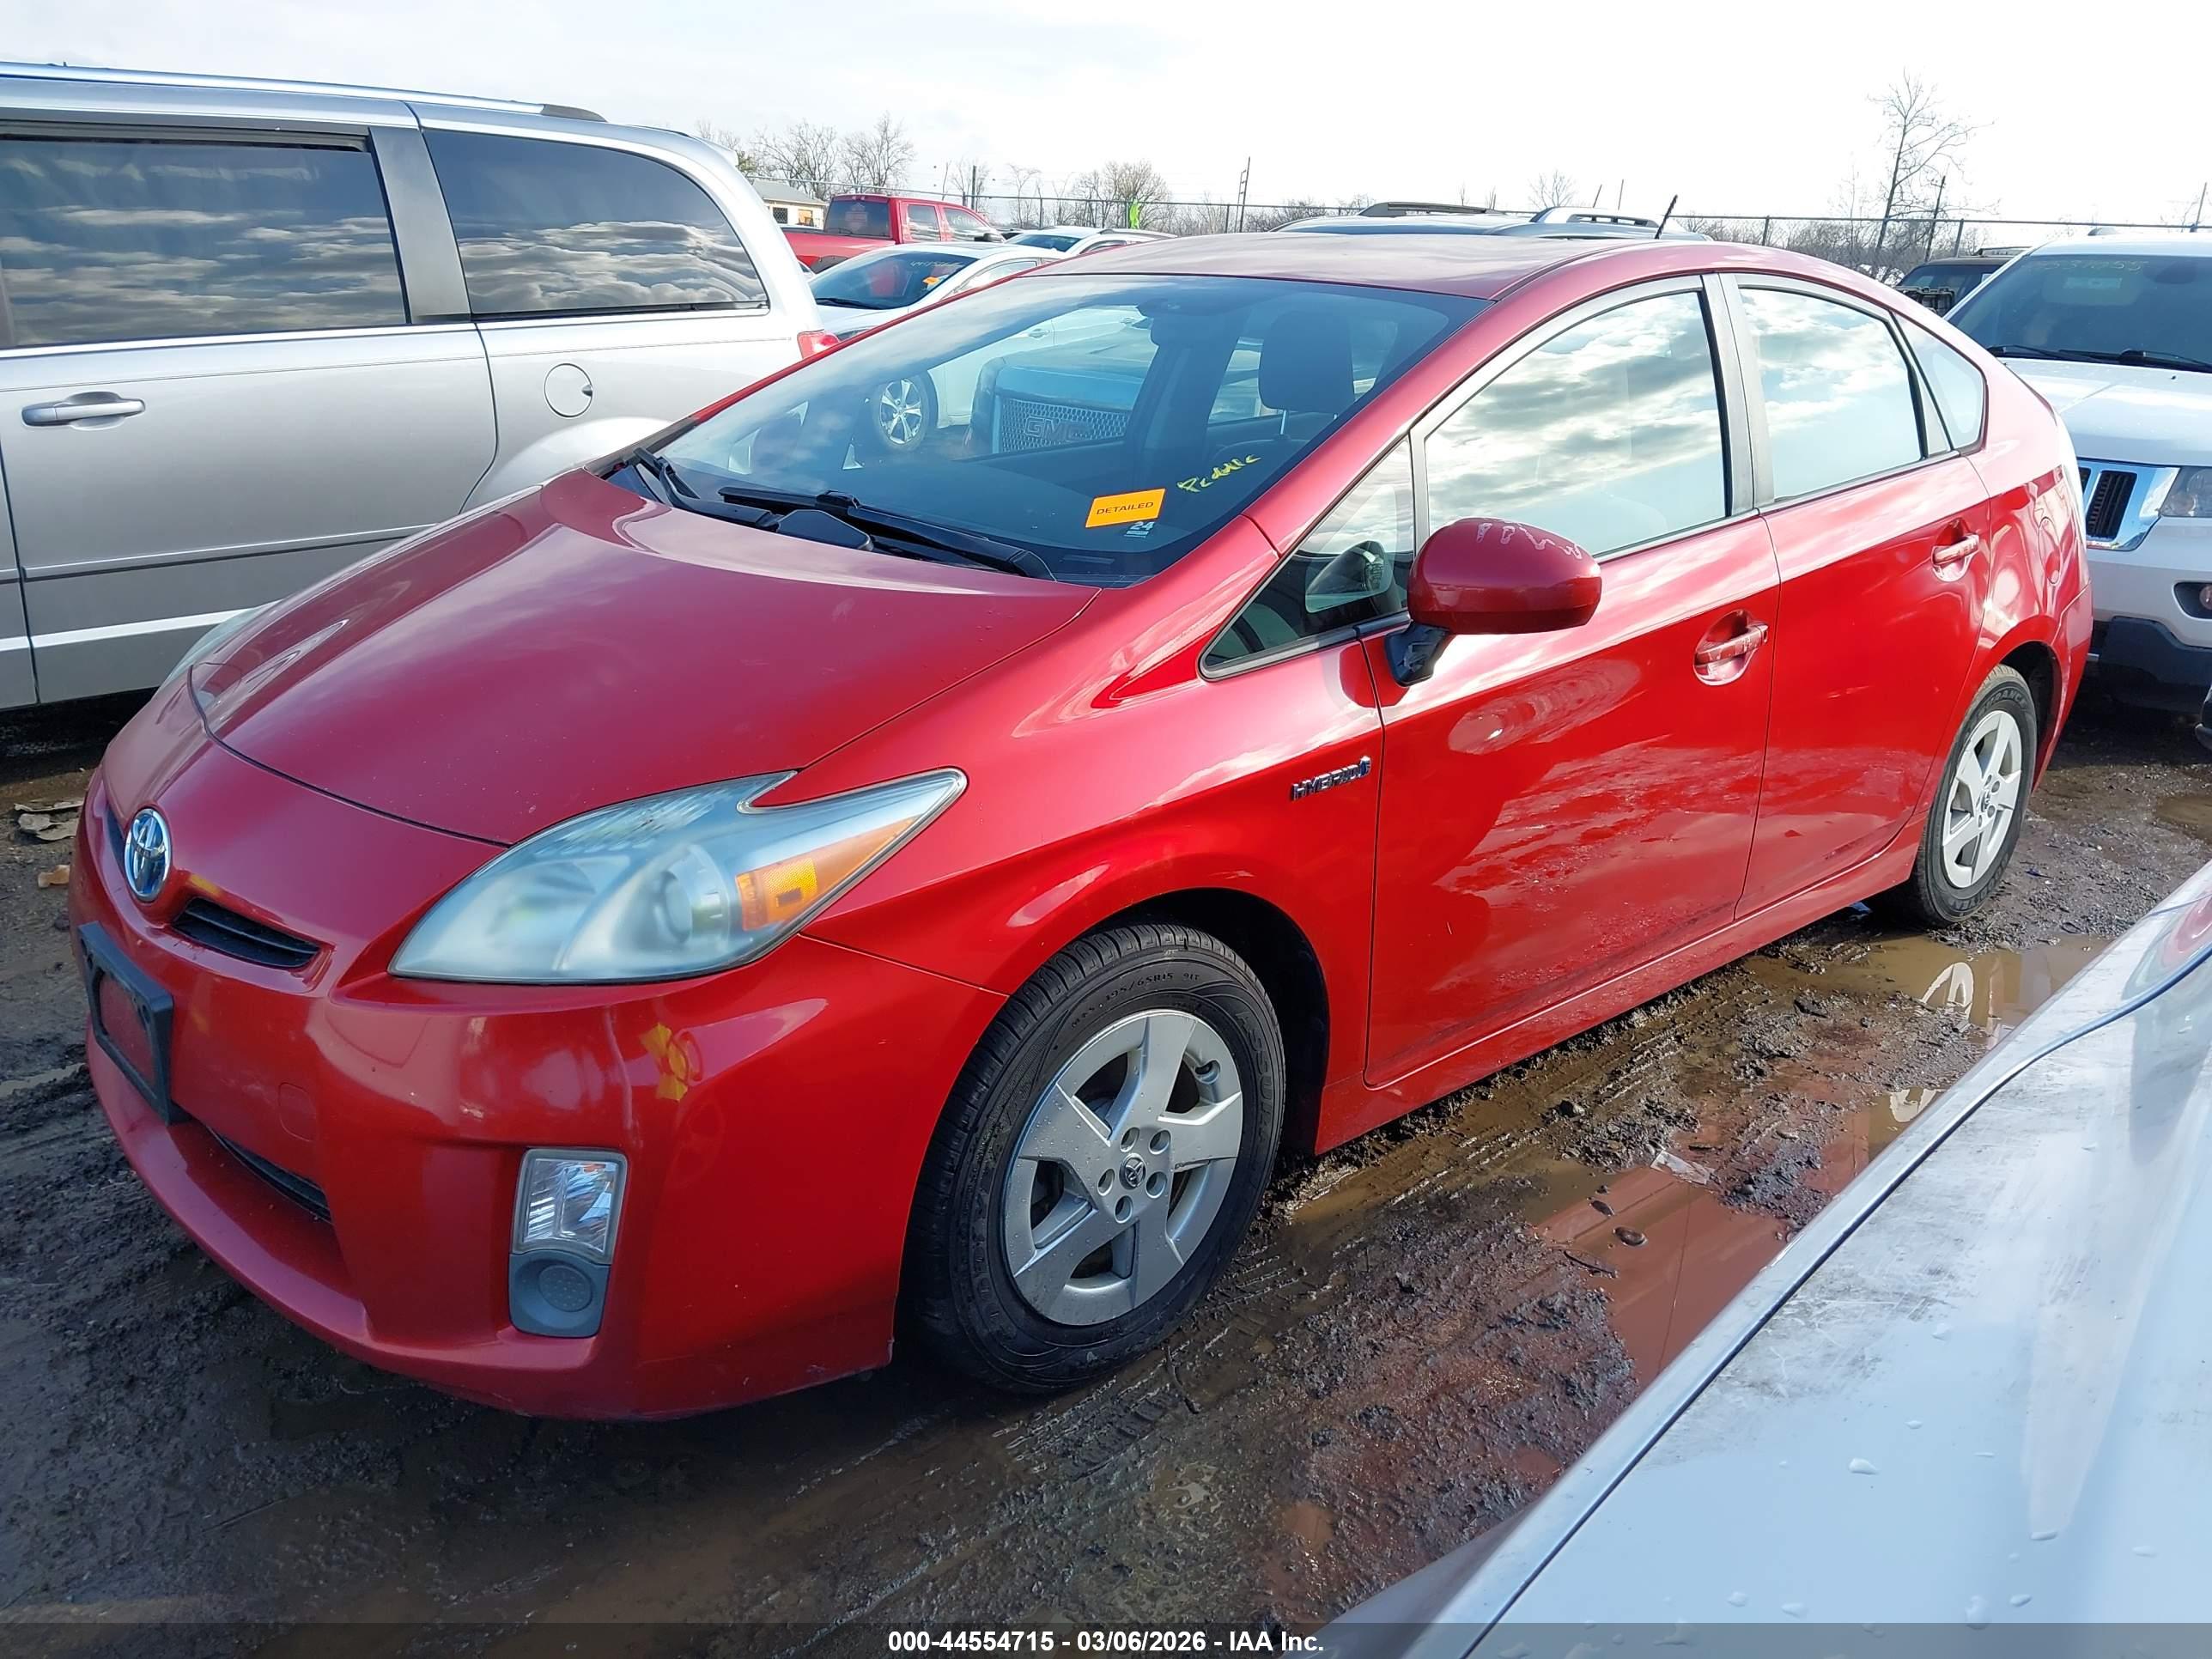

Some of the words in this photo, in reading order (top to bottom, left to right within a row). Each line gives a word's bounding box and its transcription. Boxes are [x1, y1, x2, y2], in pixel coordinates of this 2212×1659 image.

[1097, 501, 1154, 515] DETAILED
[1130, 520, 1155, 531] 24
[1290, 763, 1359, 801] HYBRID
